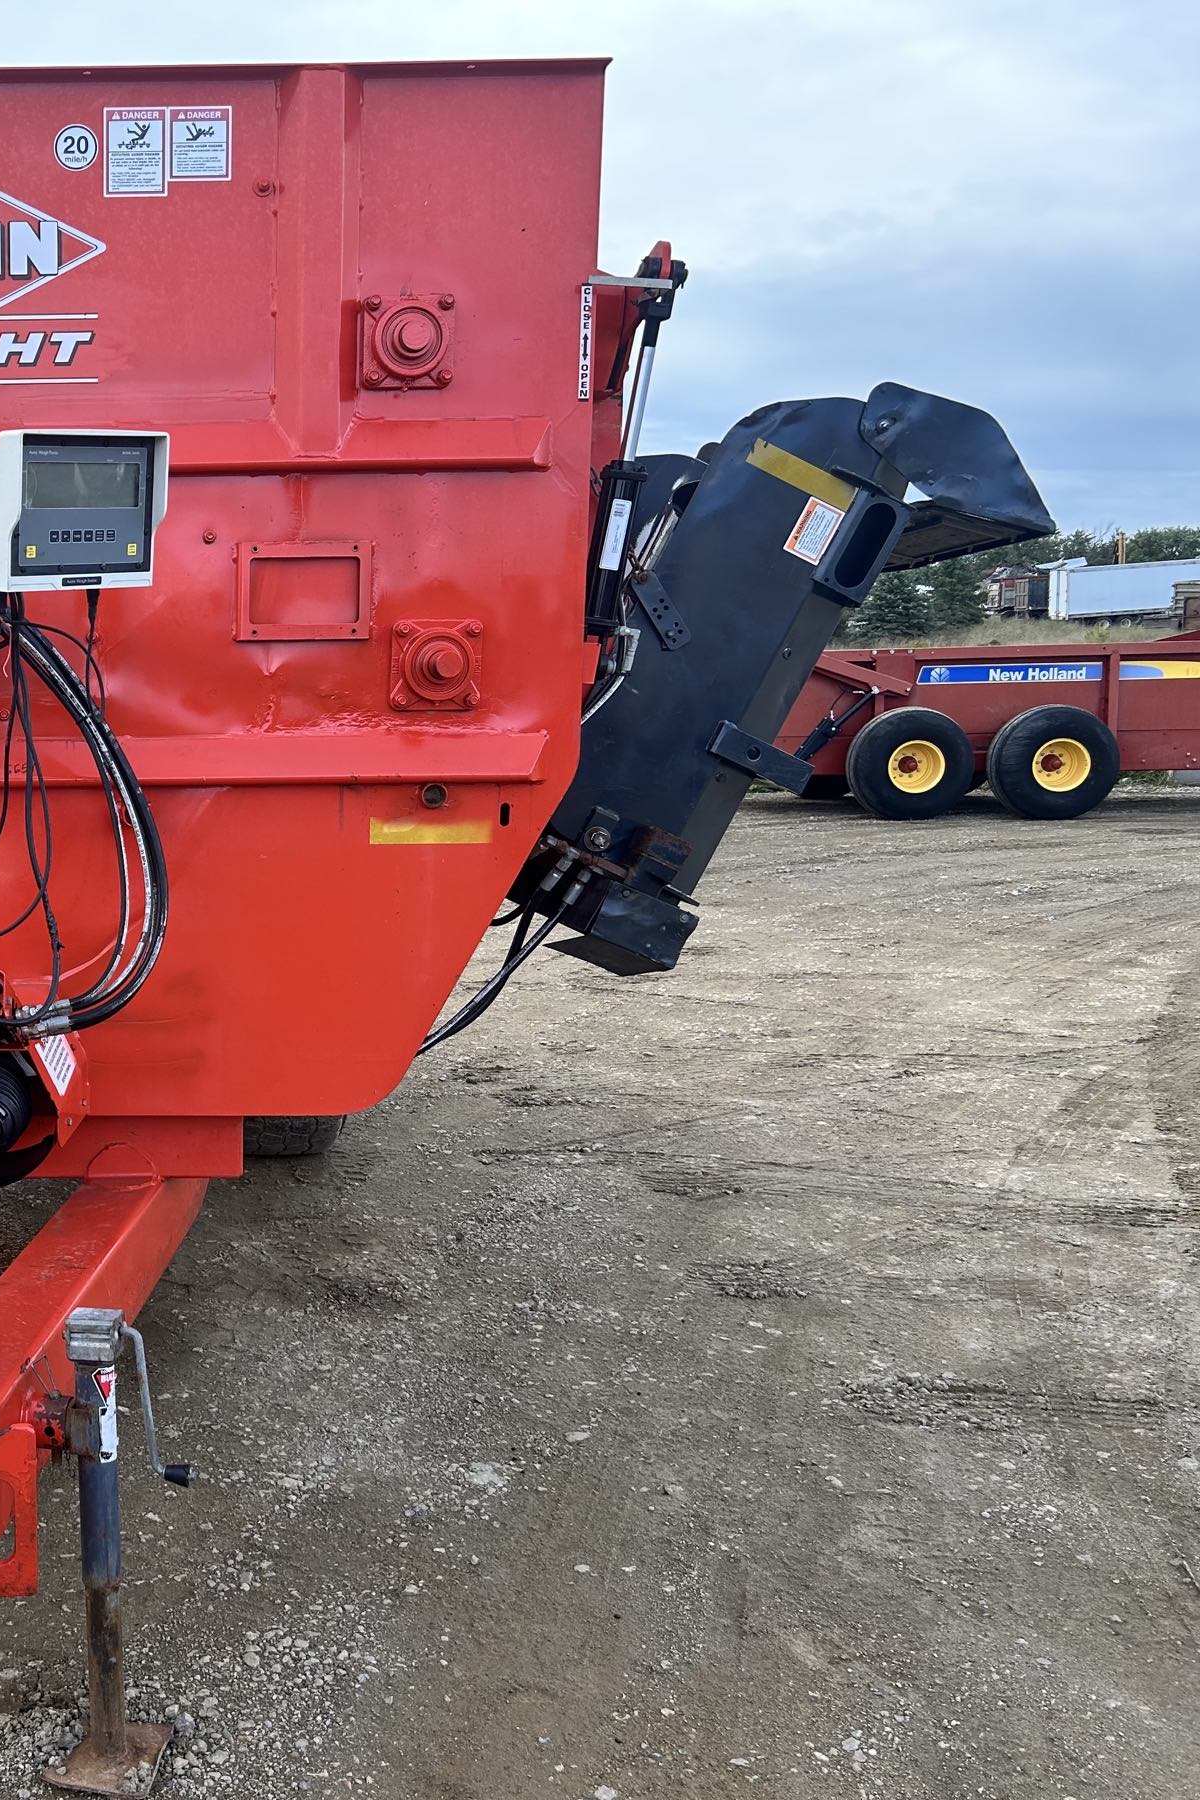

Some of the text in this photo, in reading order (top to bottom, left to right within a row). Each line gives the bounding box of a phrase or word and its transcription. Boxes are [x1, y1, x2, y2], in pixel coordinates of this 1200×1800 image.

[122, 111, 159, 119] DANGER
[187, 111, 221, 119] DANGER
[63, 135, 89, 154] 20
[583, 287, 591, 330] CLOSE
[579, 364, 588, 397] OPEN
[796, 510, 811, 534] WARNING
[989, 667, 1086, 681] New Holland
